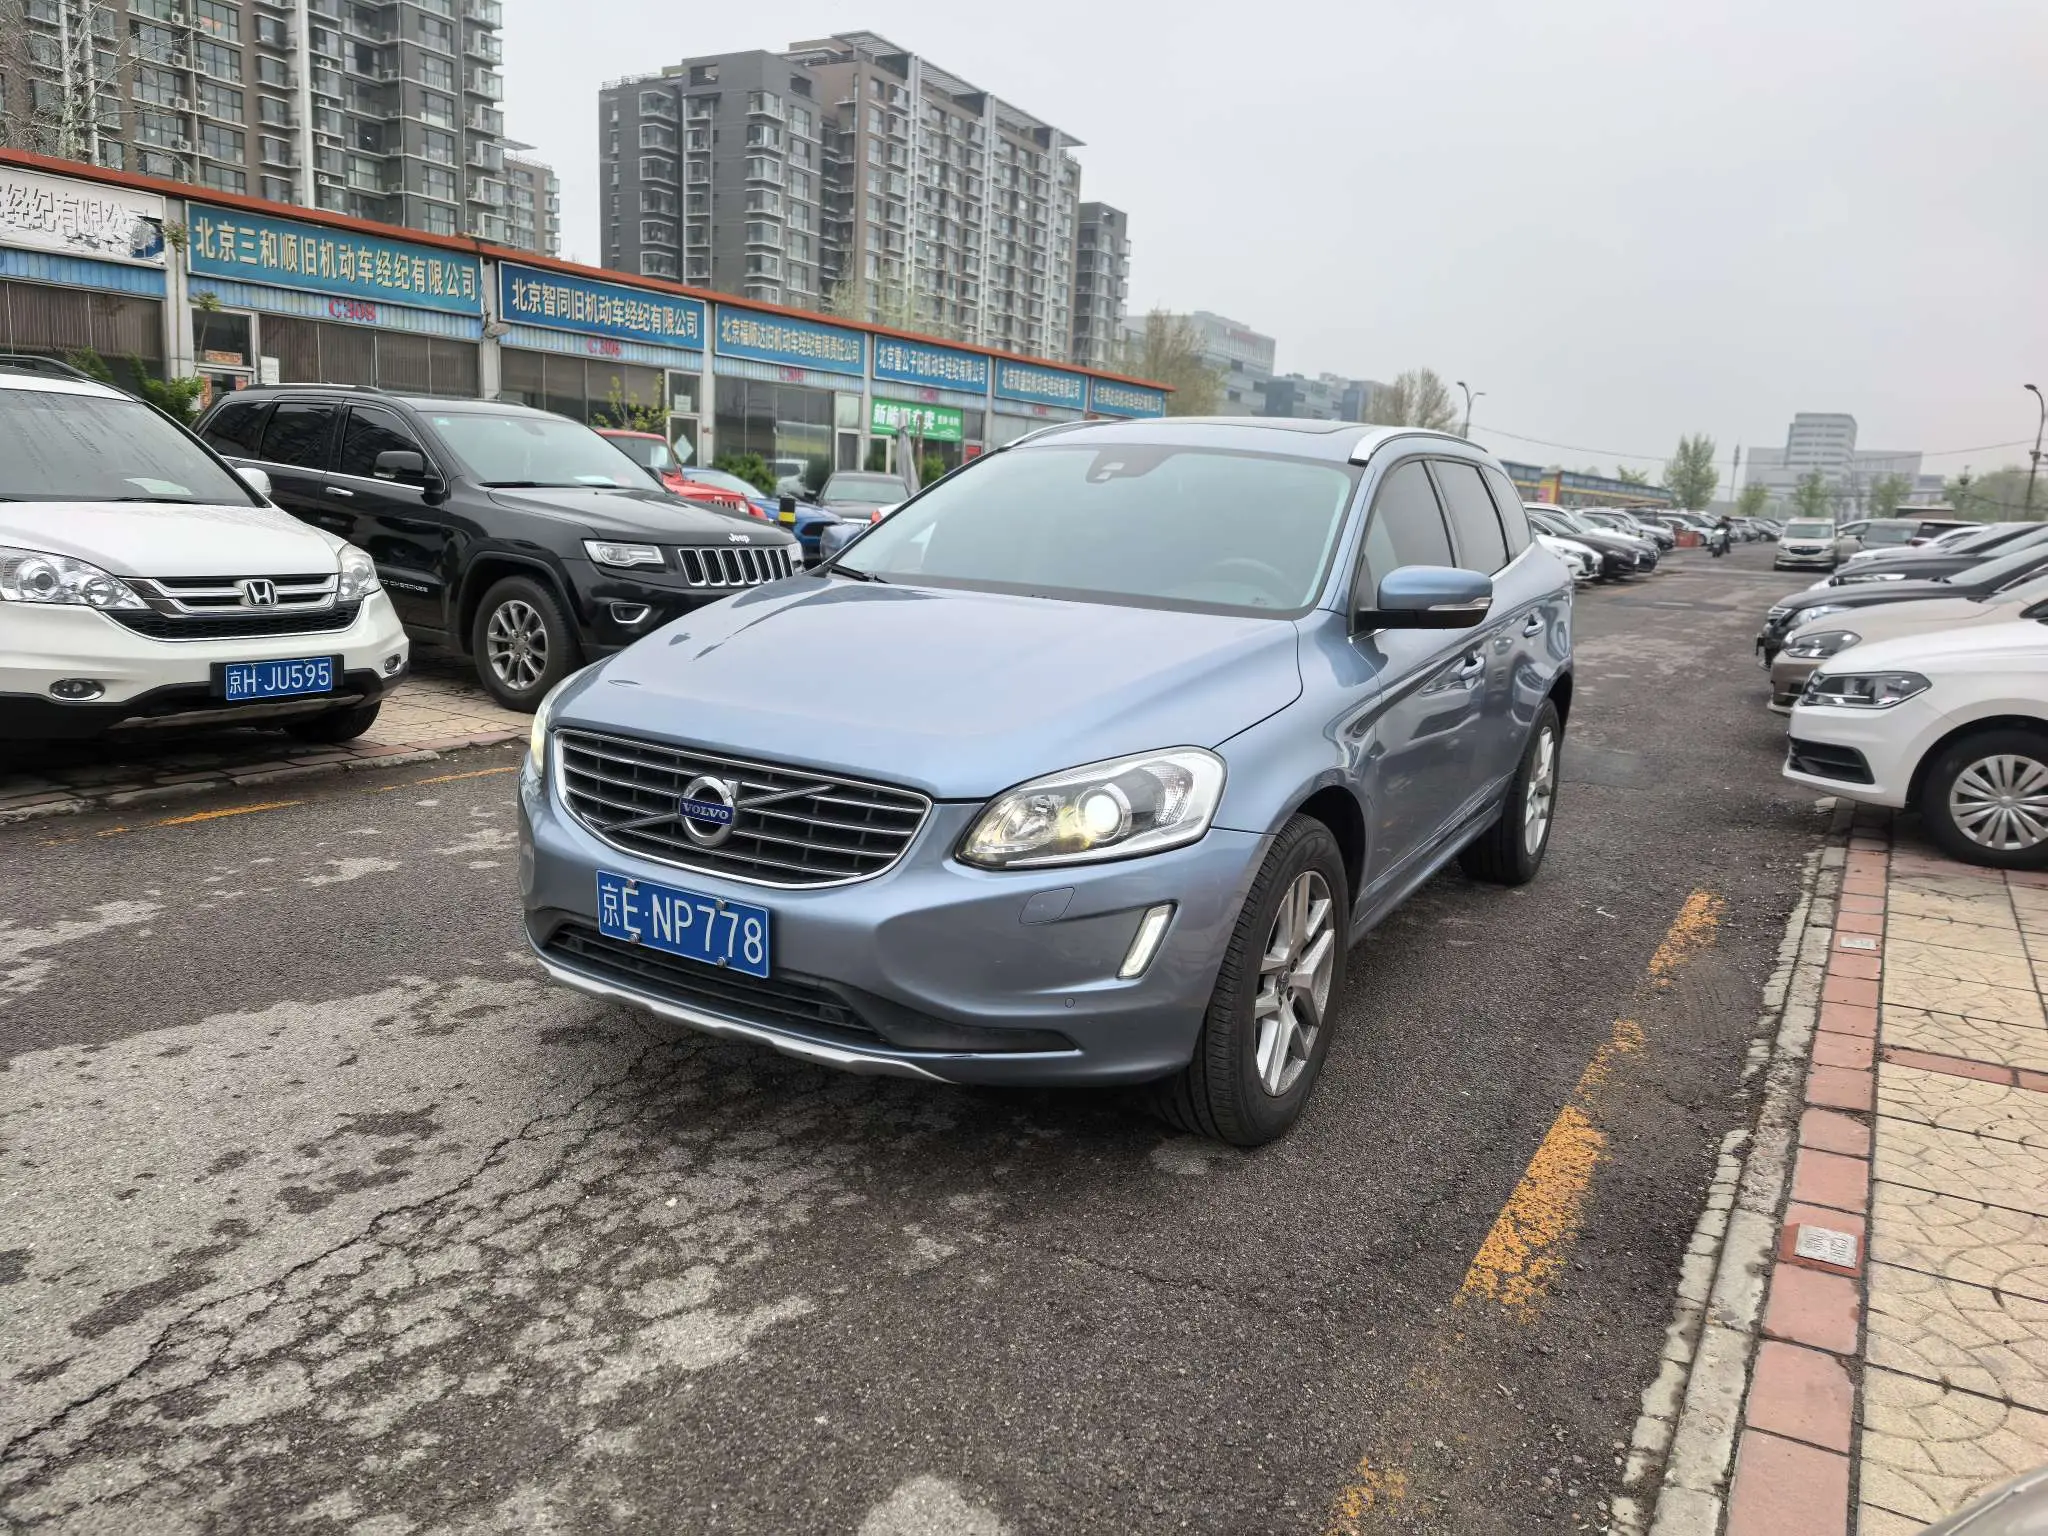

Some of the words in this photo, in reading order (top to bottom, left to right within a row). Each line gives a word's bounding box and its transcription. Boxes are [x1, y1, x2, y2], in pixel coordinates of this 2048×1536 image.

[195, 216, 477, 301] 北京三和顺旧机动车经纪有限公司
[512, 277, 699, 340] 北京智同旧机动车经纪有限公司
[729, 532, 750, 544] Jeep
[682, 802, 729, 820] VOLVO
